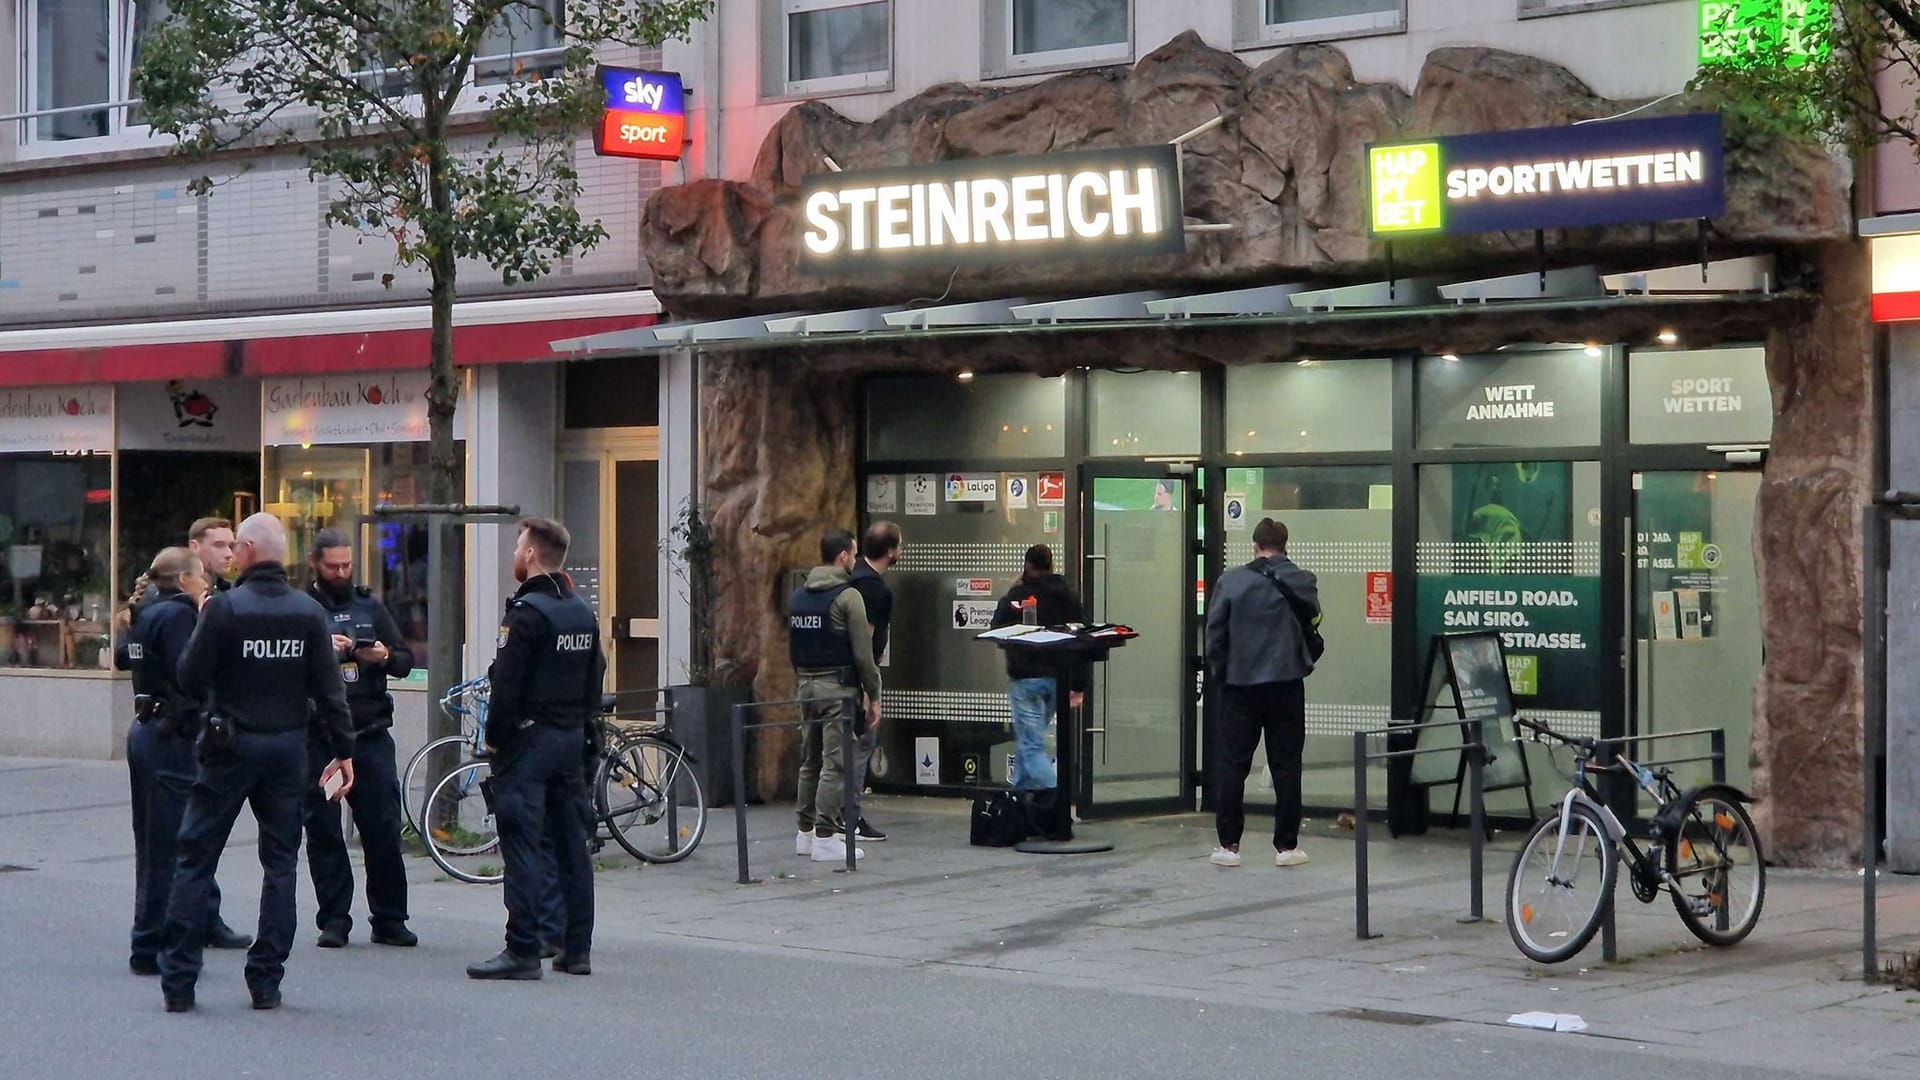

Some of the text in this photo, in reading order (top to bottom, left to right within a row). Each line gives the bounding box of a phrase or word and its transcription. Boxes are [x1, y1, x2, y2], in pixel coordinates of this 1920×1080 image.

[624, 77, 664, 111] sky
[620, 125, 667, 144] sport
[1376, 150, 1427, 177] HAP
[1447, 151, 1701, 199] SPORTWETTEN
[1377, 176, 1410, 202] PY
[804, 168, 1161, 254] STEINREICH
[1378, 200, 1425, 226] BET
[1485, 385, 1535, 401] WETT
[1671, 377, 1734, 395] SPORT
[1466, 401, 1554, 420] ANNAHME
[1663, 395, 1742, 413] WETTEN
[1443, 590, 1579, 606] ANFIELD ROAD.
[791, 615, 822, 629] POLIZEI
[1443, 611, 1530, 627] SAN SIRO.
[242, 639, 304, 658] POLIZEI
[556, 633, 593, 652] POLIZEI
